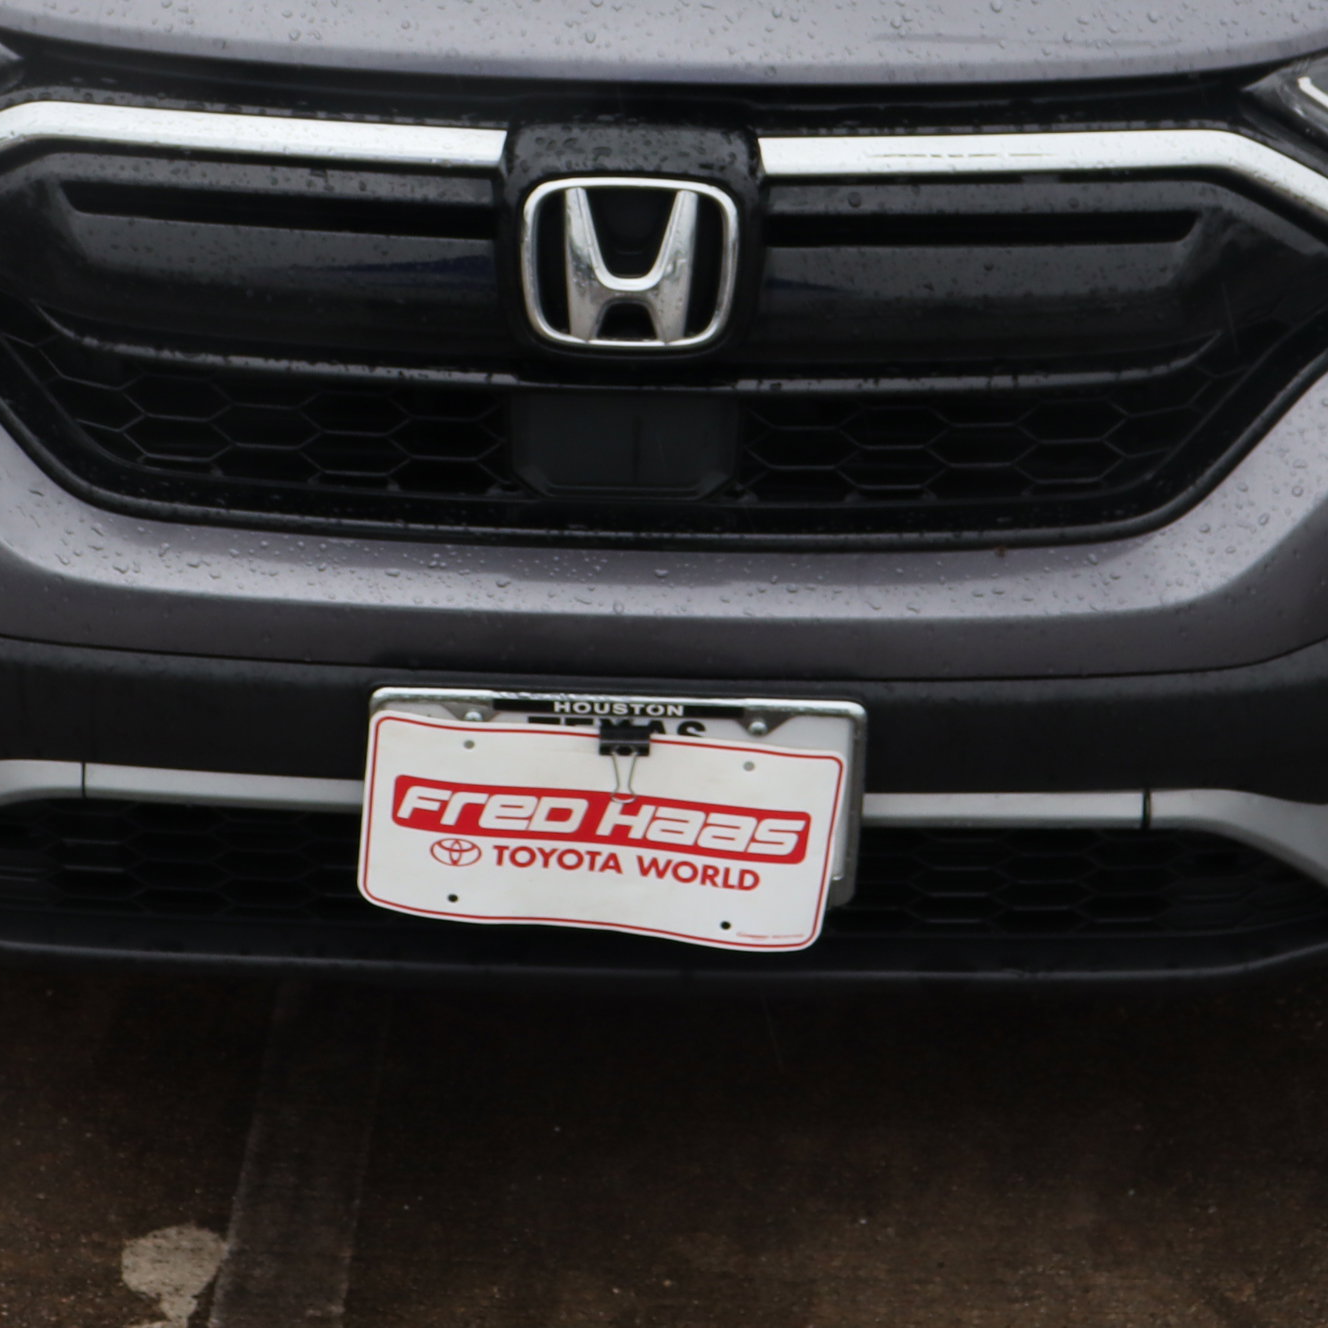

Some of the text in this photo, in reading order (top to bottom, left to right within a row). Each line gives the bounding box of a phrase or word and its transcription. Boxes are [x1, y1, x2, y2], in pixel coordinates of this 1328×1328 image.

[553, 700, 685, 717] HOUSTON
[595, 800, 807, 856] Haas
[492, 844, 761, 891] TOYOTA WORLD
